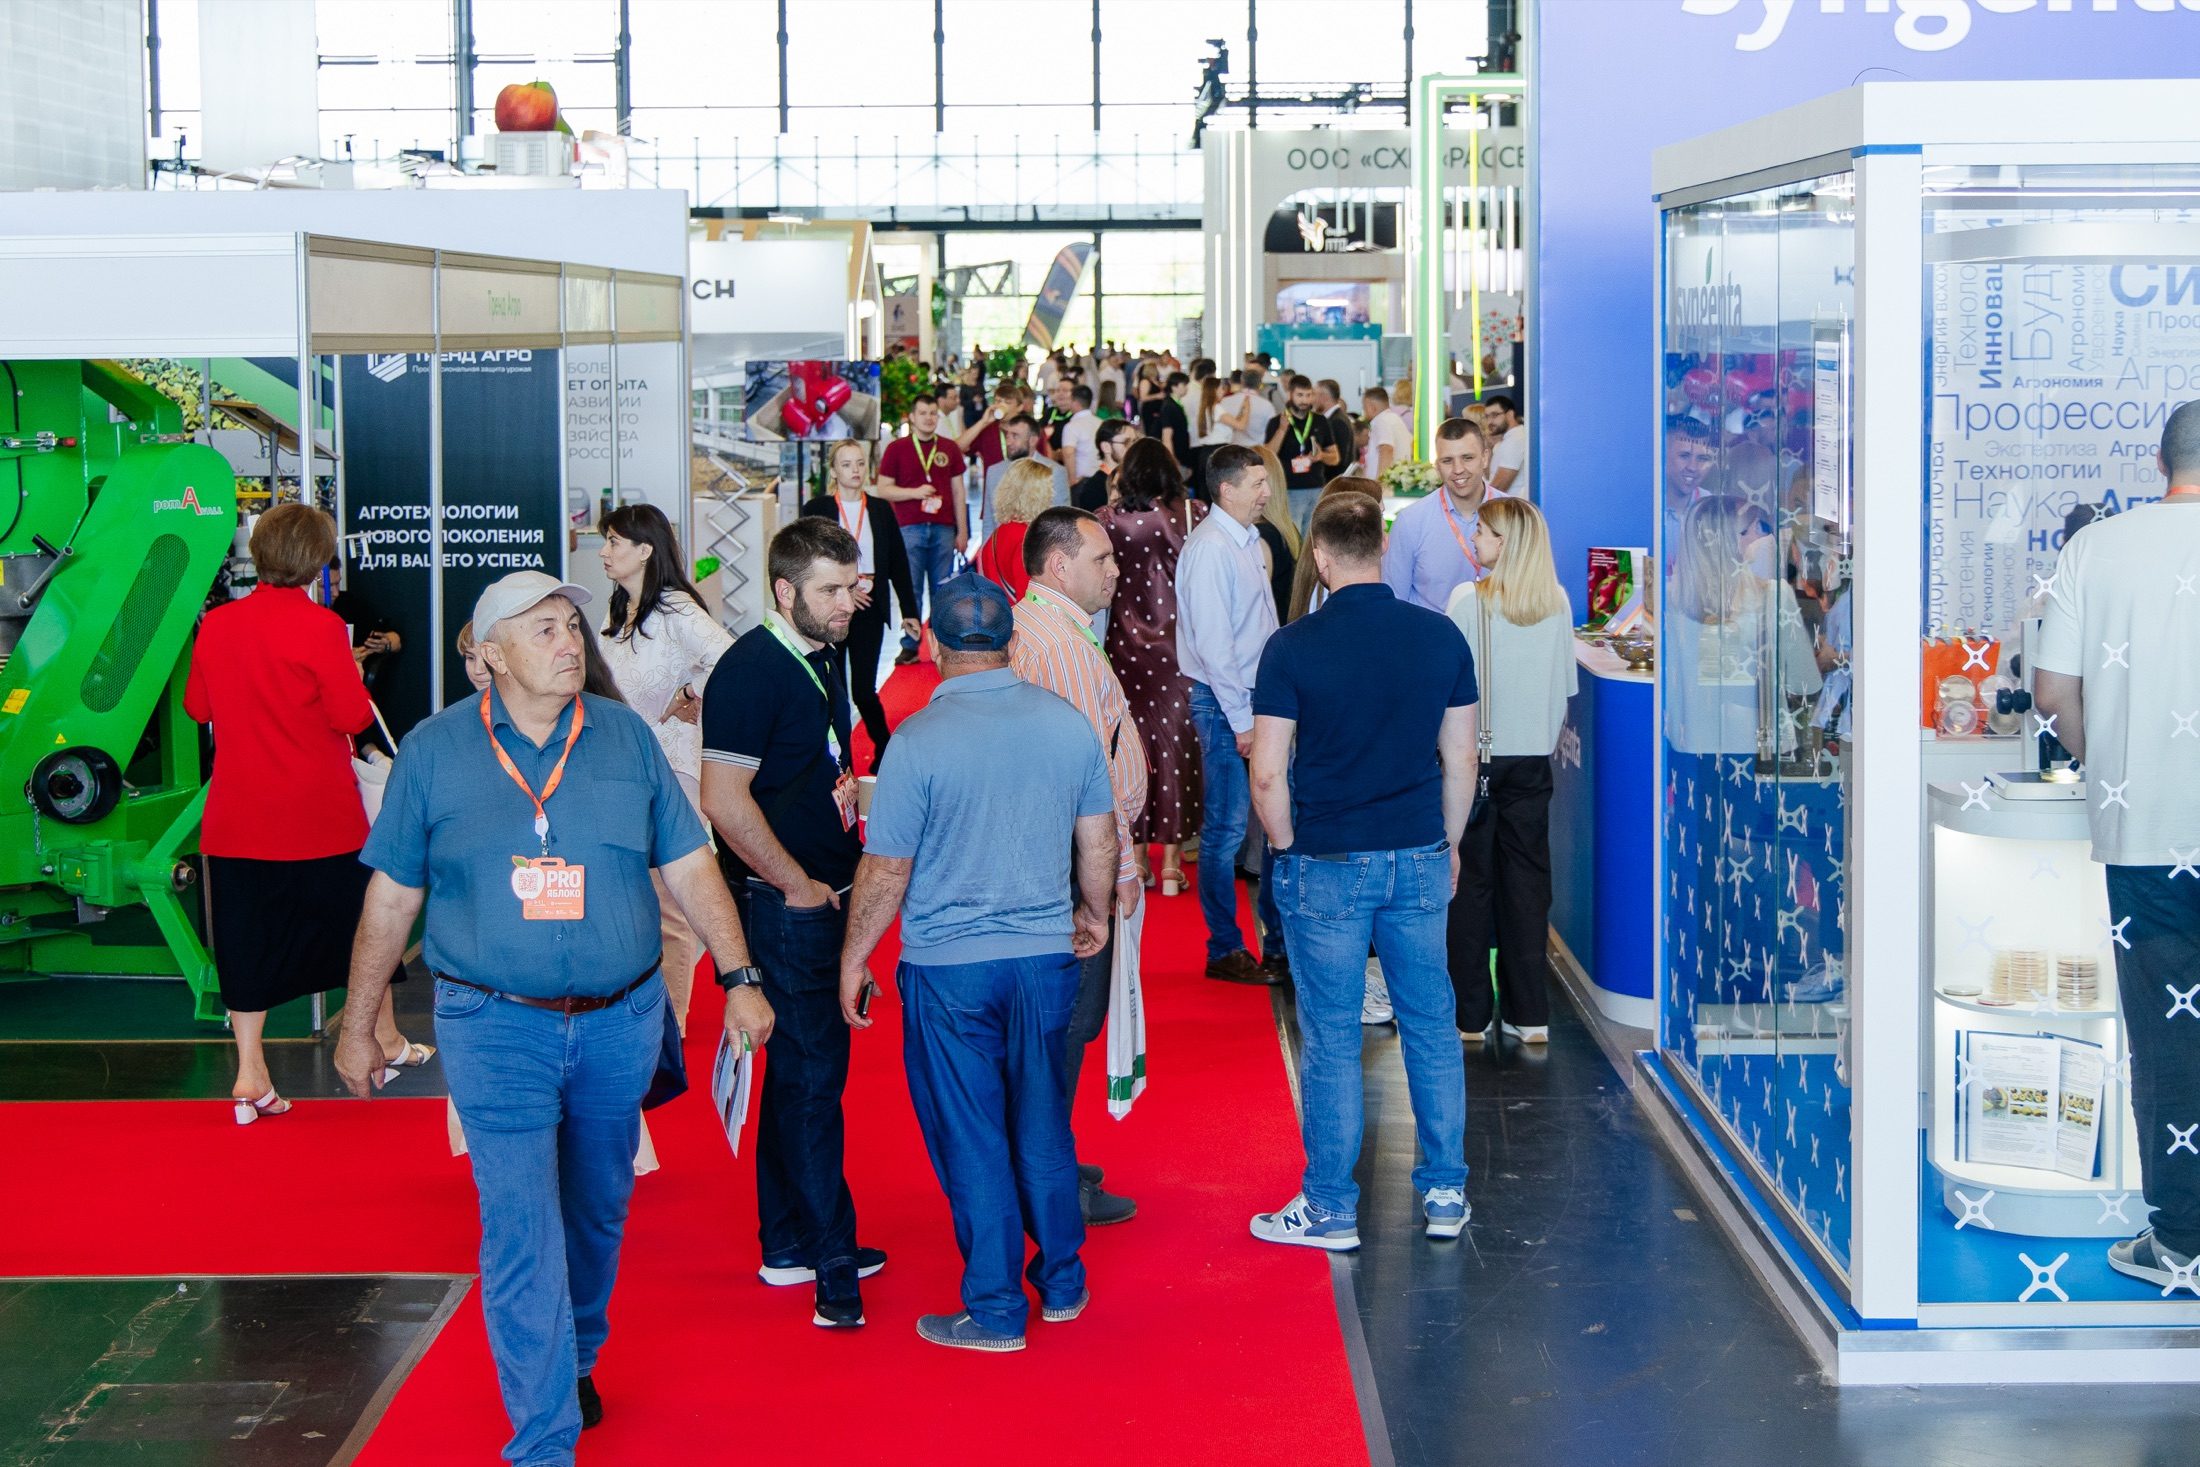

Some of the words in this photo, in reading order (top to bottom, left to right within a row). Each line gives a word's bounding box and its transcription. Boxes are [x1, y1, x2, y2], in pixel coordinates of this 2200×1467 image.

[1361, 147, 1412, 169] «СХ
[2010, 264, 2064, 361] Буд
[2112, 311, 2126, 356] Наука
[481, 349, 533, 362] АГРО
[2012, 375, 2103, 390] Агрономия
[568, 396, 641, 408] АЗВИИИ
[567, 413, 639, 425] ЛЬСКГО
[567, 429, 639, 442] ЗЯЙСВА
[1954, 460, 2101, 480] Технологии
[358, 505, 519, 520] АГРОТЕХОЛОГИИ
[1954, 482, 2080, 527] Наука
[359, 554, 397, 571] ДЛЯ
[477, 553, 545, 568] УСПЕХА
[546, 870, 581, 888] PRO
[546, 889, 581, 898] ЯБЛОКО
[1282, 1210, 1303, 1232] N
